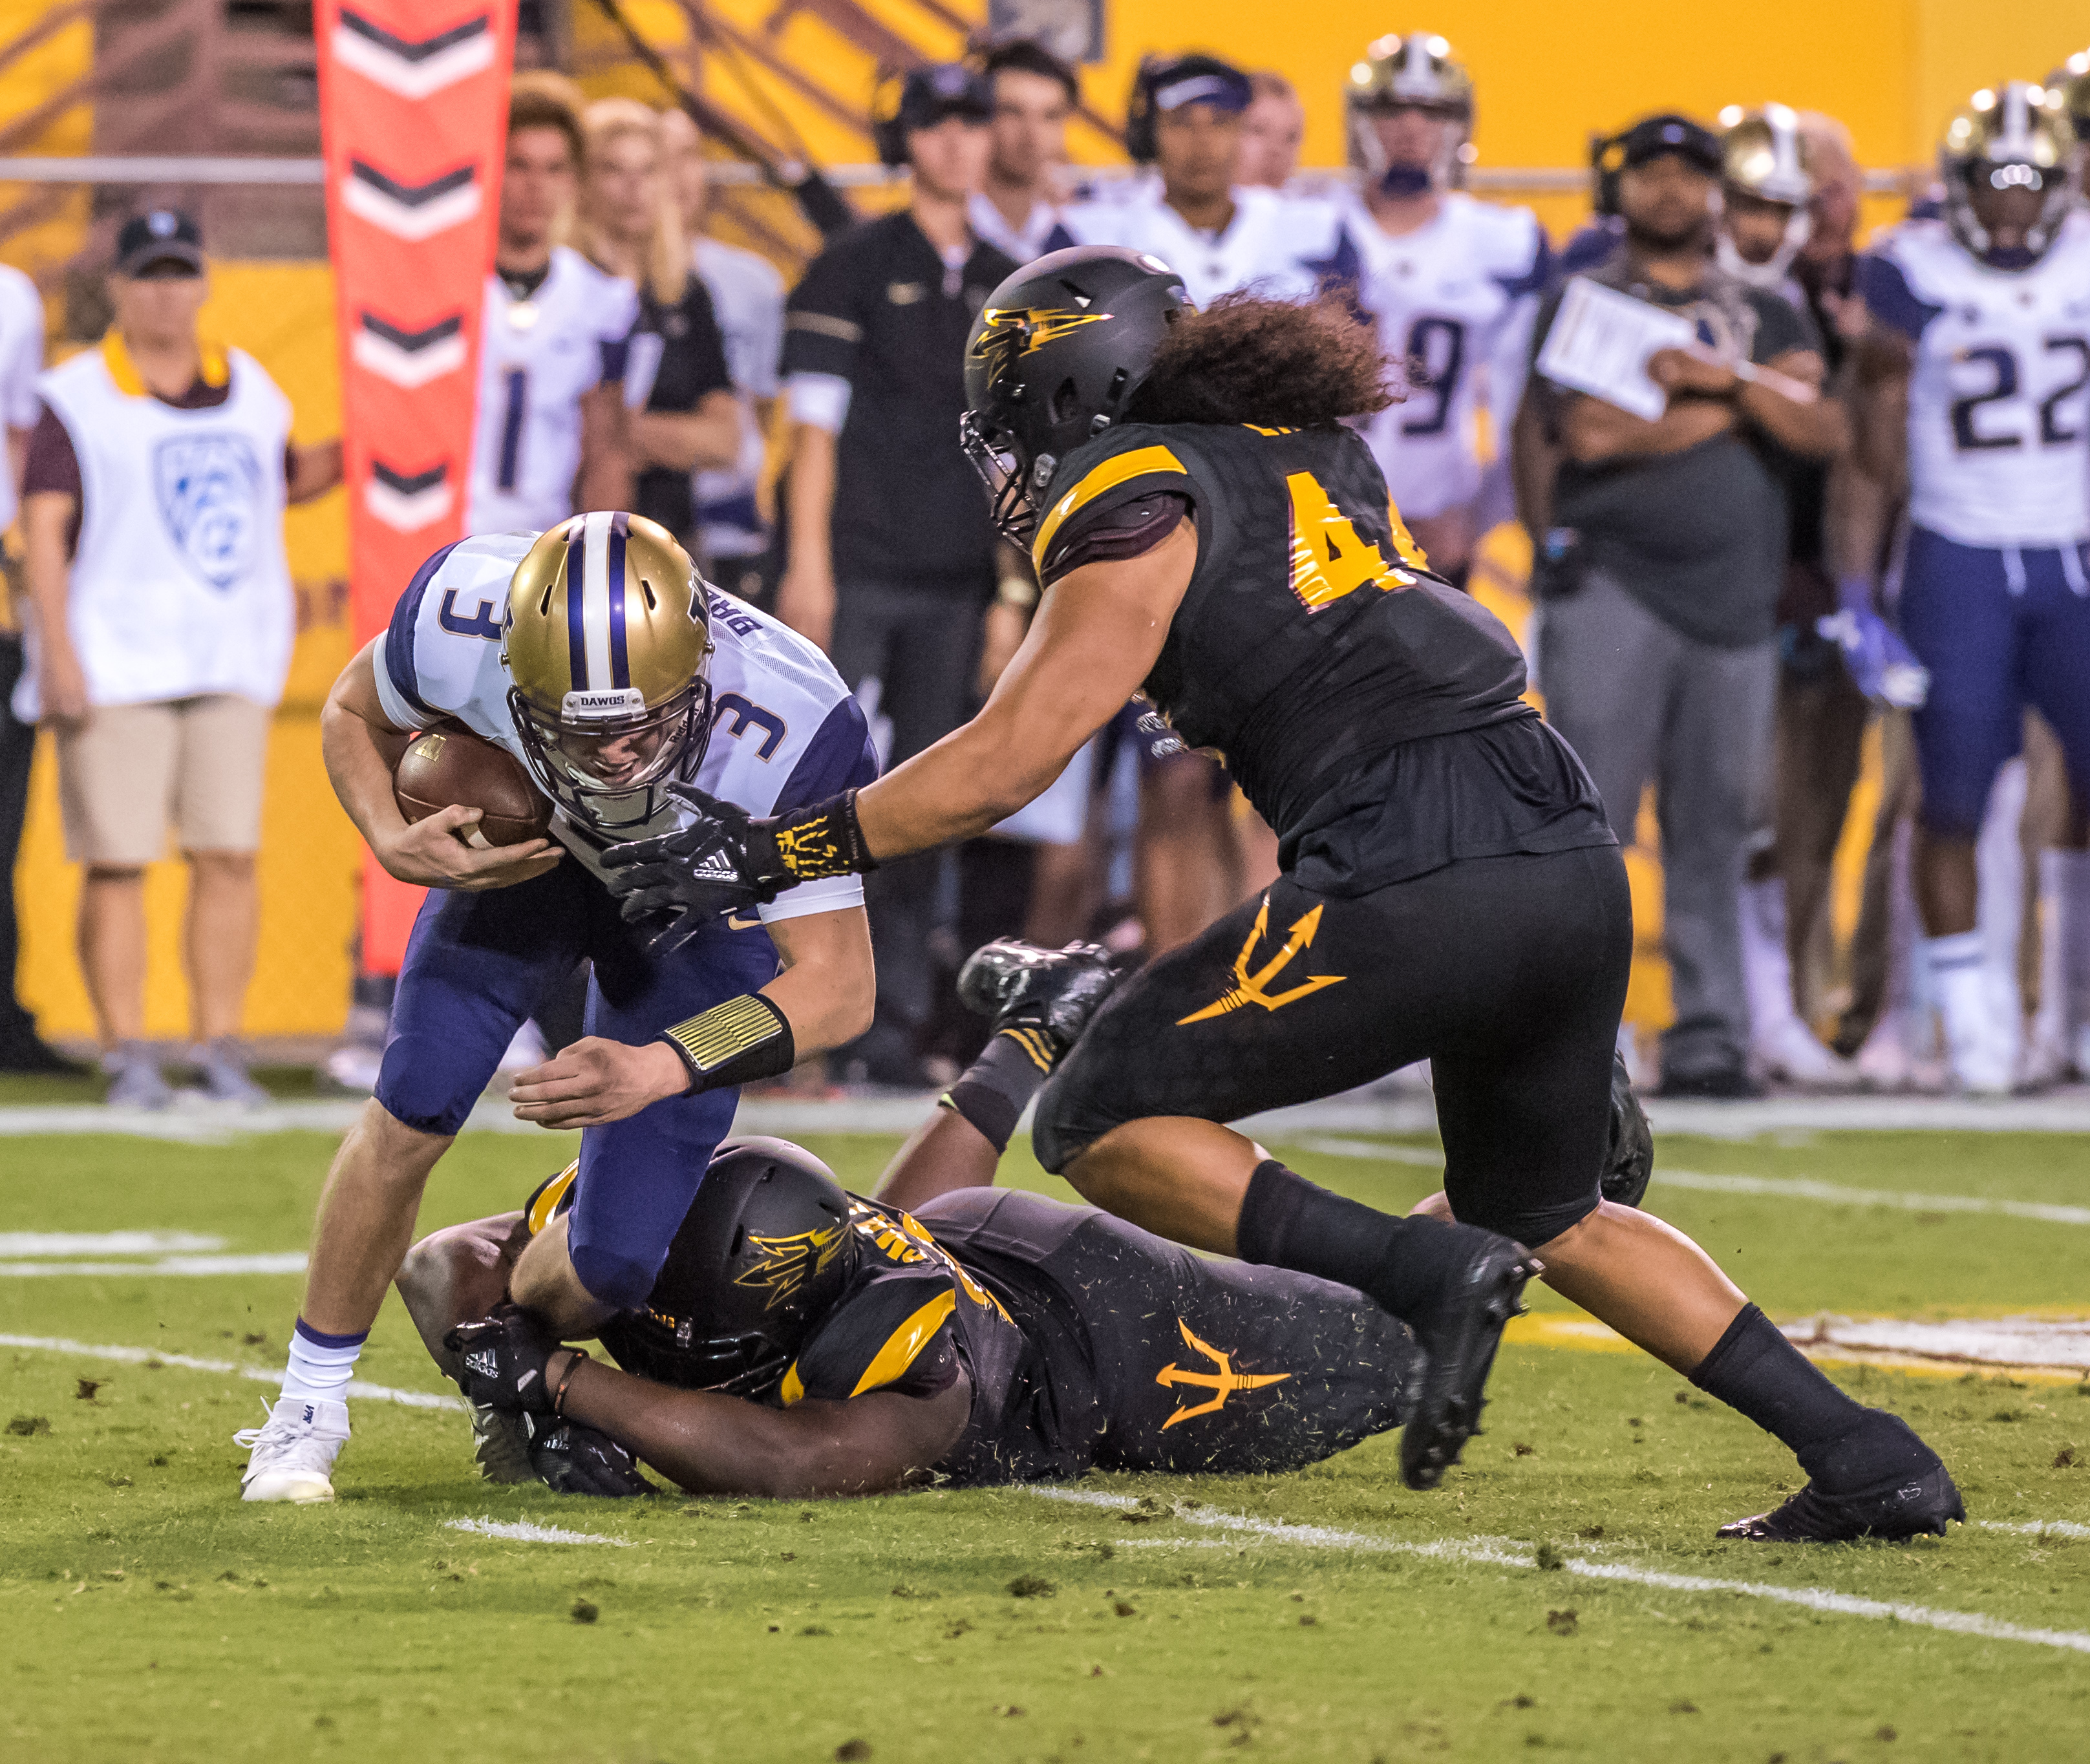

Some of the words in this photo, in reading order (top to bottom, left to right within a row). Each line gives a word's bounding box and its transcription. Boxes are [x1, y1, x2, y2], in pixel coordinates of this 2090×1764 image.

[1950, 336, 2090, 451] 22
[438, 588, 503, 643] 3
[581, 696, 624, 706] DAWGS
[711, 691, 788, 763] 3
